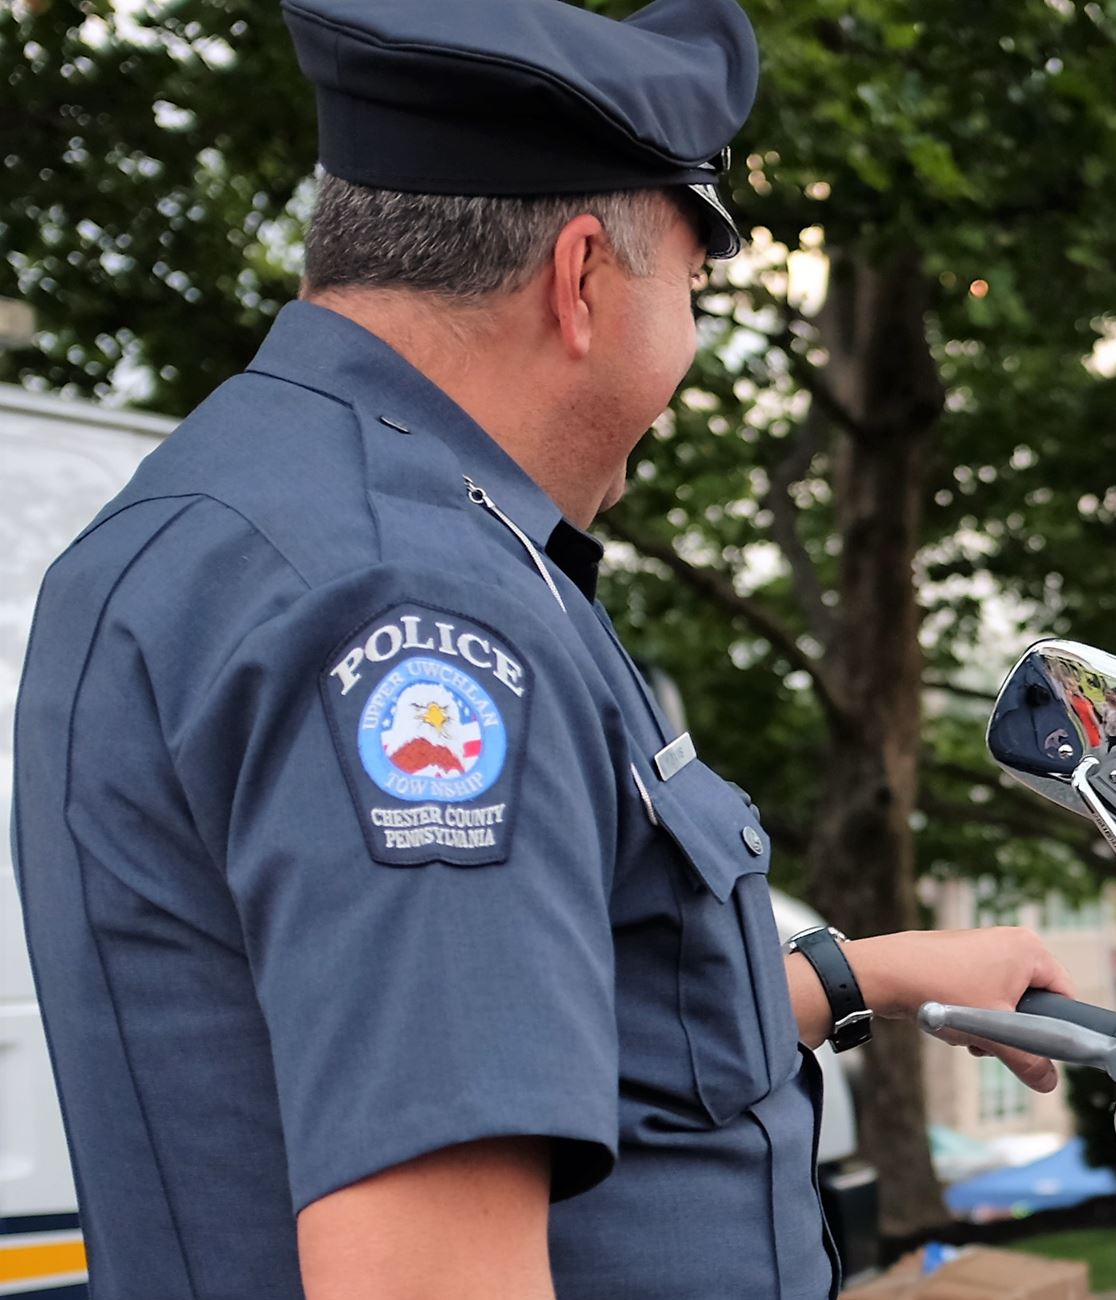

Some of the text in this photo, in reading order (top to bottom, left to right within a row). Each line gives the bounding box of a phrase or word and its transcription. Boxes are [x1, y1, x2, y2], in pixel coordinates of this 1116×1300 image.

[329, 615, 525, 698] POLICE
[362, 660, 498, 730] UPPER UWCHLAN
[386, 772, 485, 797] TOWNSHIP
[370, 803, 506, 827] CHESTER COUNTY
[384, 827, 496, 848] PENNSYLVANIA
